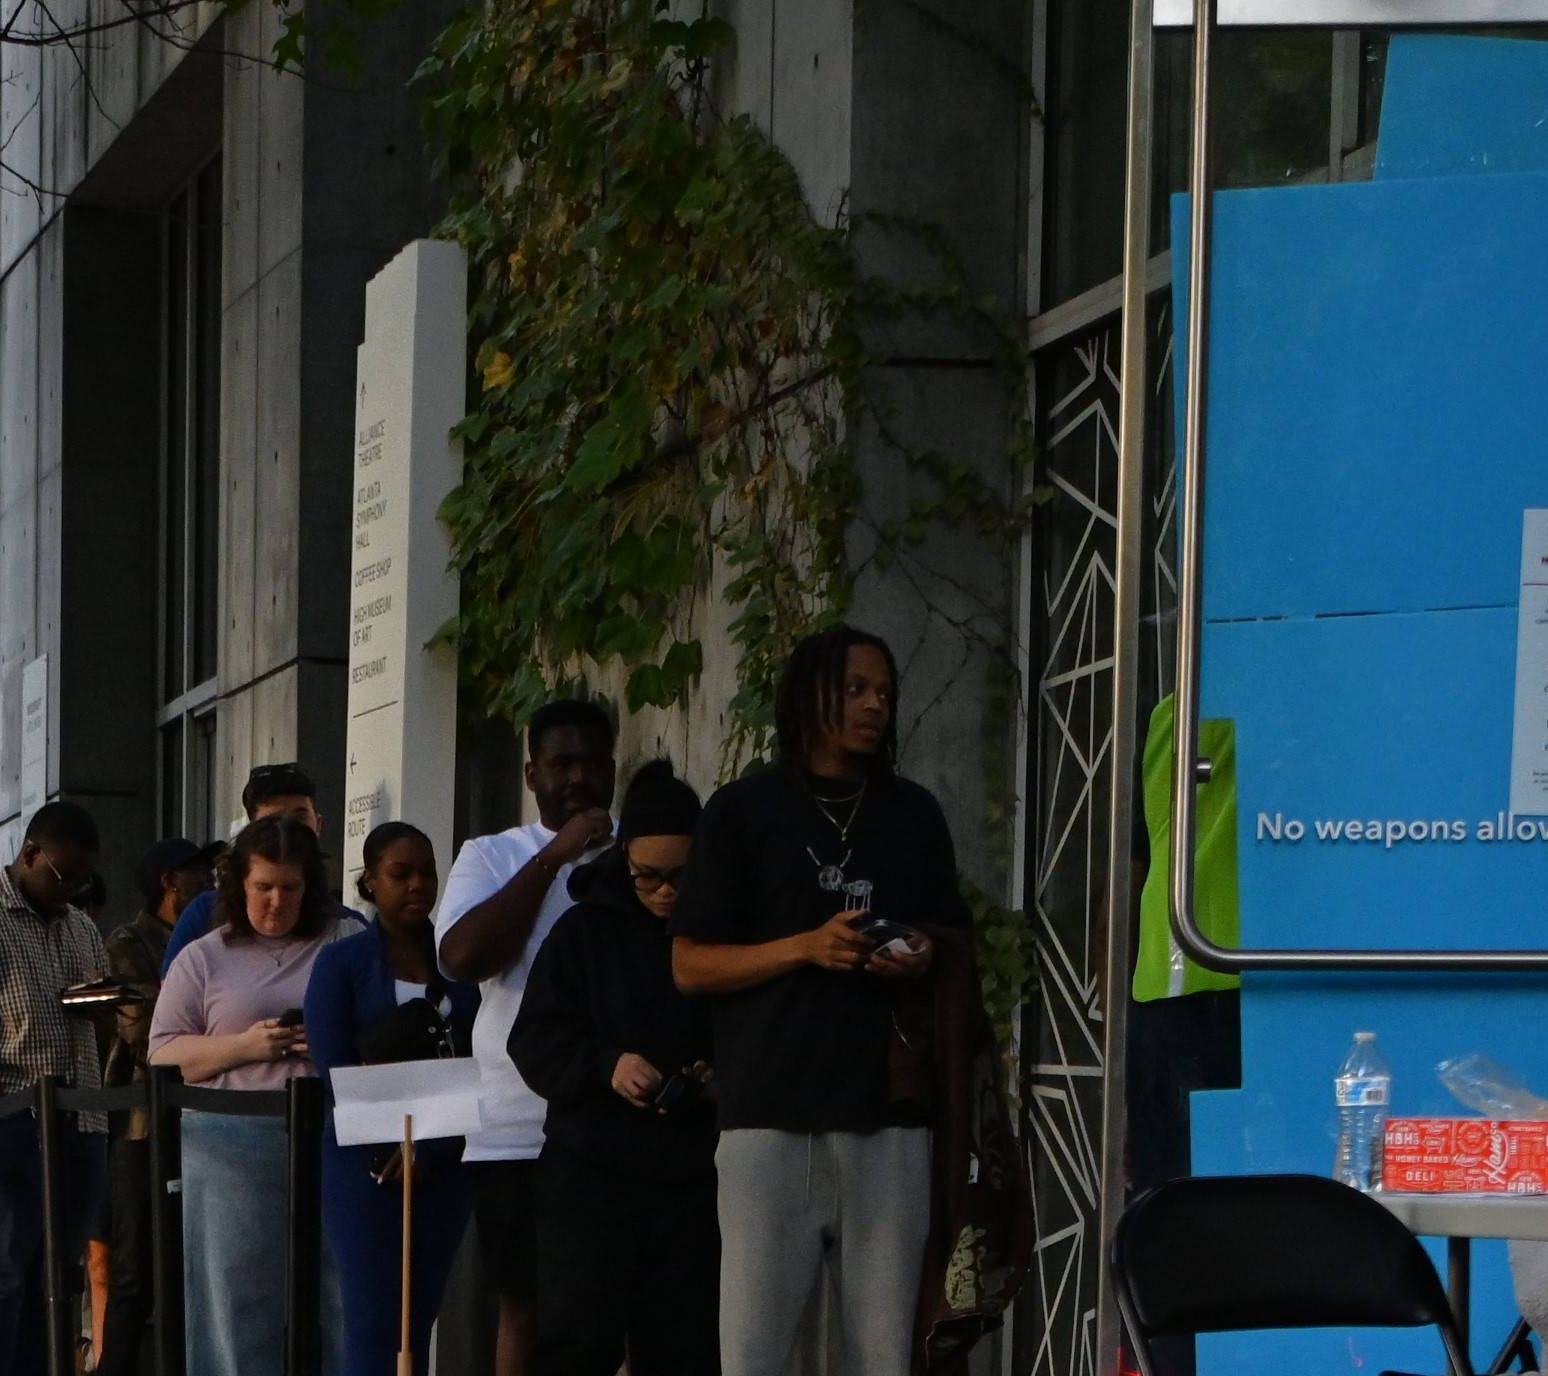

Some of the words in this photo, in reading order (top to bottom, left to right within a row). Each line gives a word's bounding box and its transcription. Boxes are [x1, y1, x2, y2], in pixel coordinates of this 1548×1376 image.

[355, 562, 376, 588] COFFEE
[376, 557, 392, 578] SHOP
[367, 594, 392, 618] MUSEUM
[362, 624, 373, 643] ART
[352, 656, 387, 684] RESTAURANT
[1256, 812, 1304, 842] No
[1315, 818, 1466, 849] weapons
[1385, 1132, 1413, 1145] HBH
[1406, 1170, 1434, 1182] DELI
[1508, 1182, 1535, 1193] HBH
